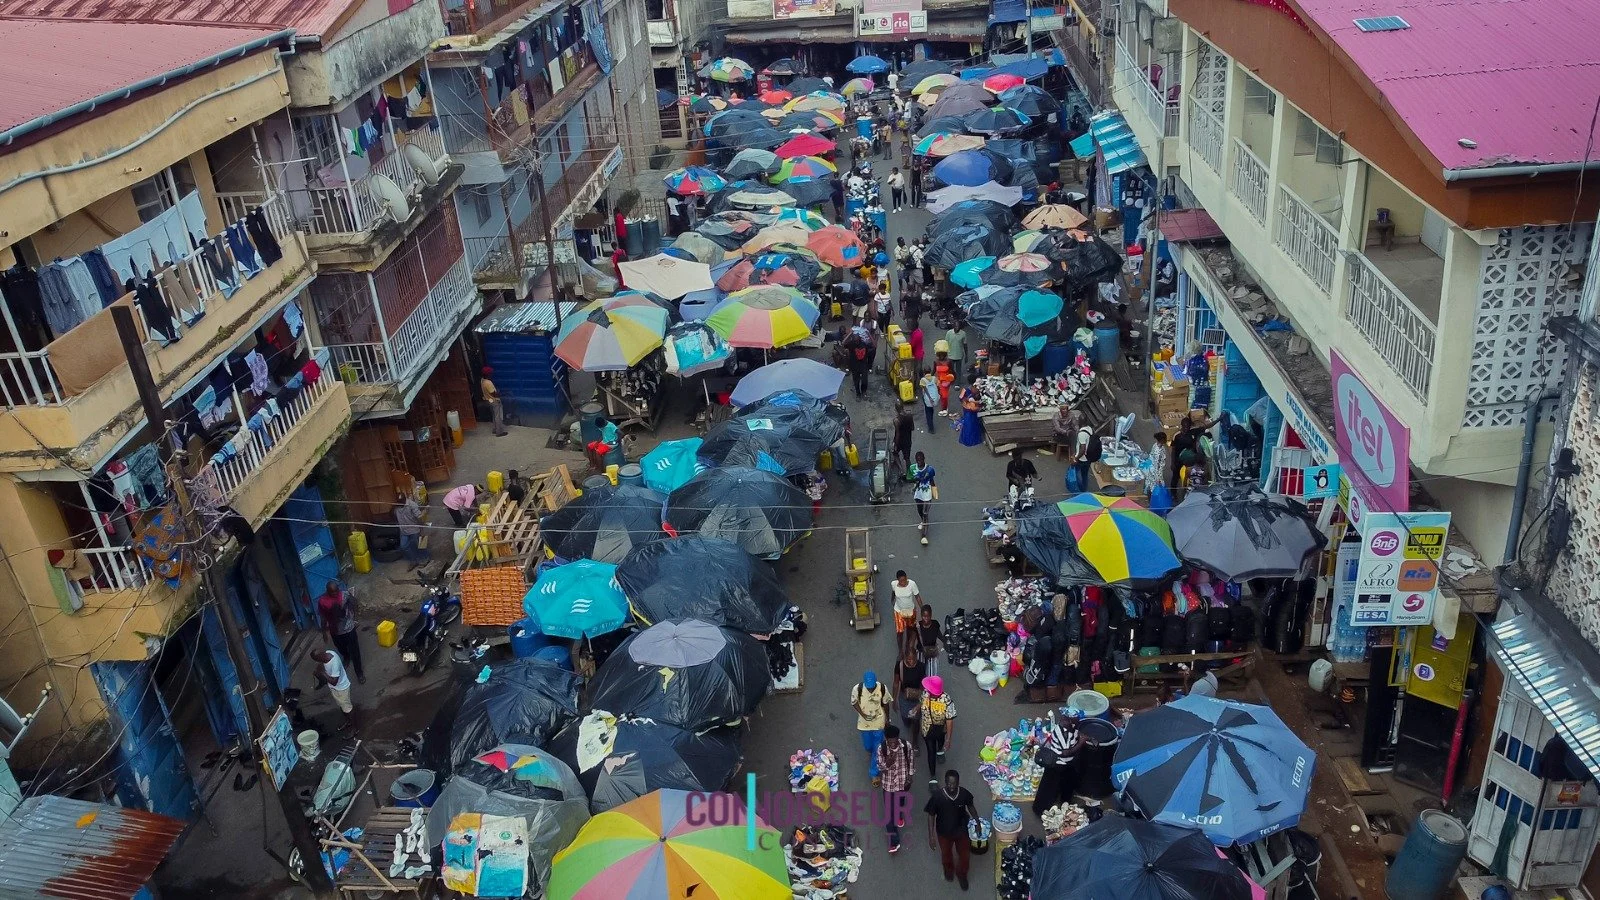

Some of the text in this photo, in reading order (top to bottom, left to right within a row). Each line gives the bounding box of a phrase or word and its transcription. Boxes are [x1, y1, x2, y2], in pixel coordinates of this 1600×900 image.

[894, 17, 909, 28] ria
[1348, 389, 1384, 474] itel
[1371, 537, 1399, 549] BnB
[1404, 567, 1432, 578] Ria
[1291, 755, 1306, 788] TECNO
